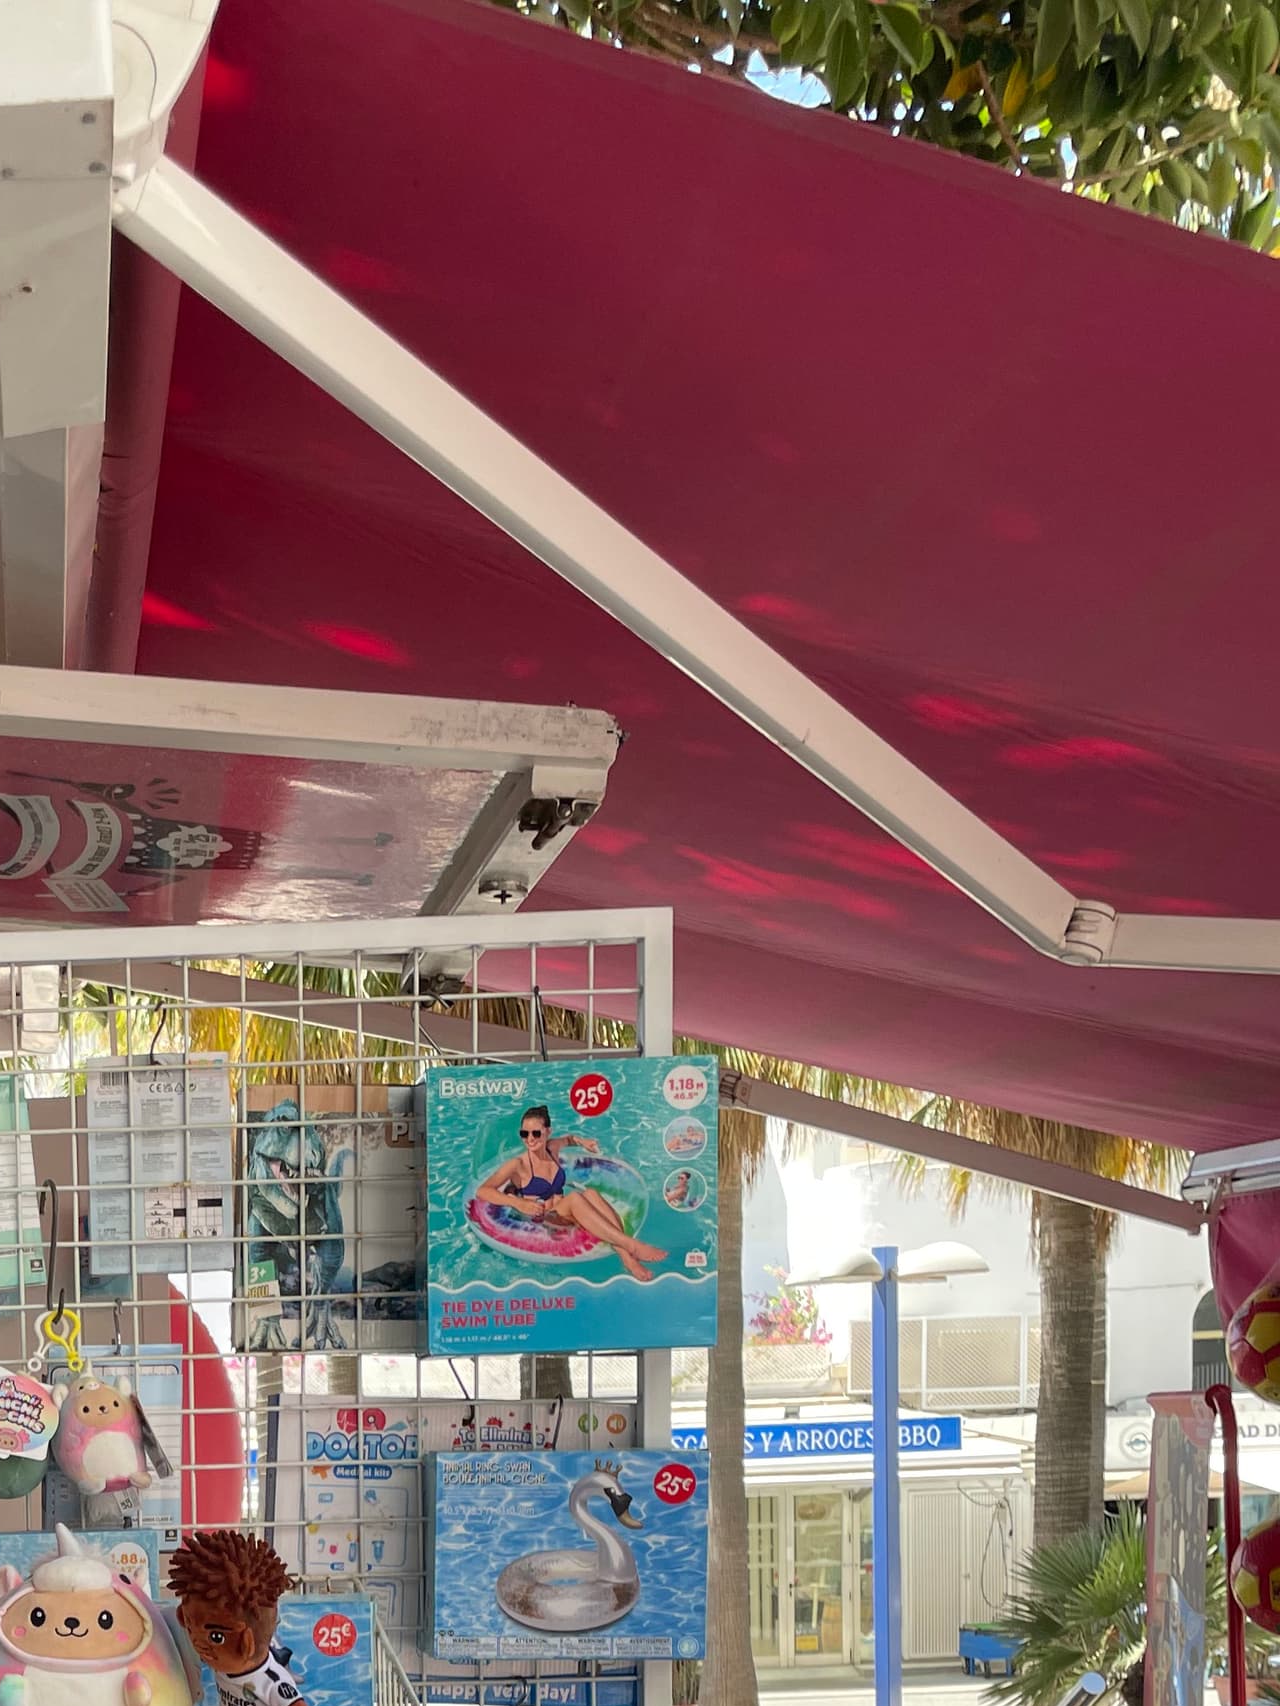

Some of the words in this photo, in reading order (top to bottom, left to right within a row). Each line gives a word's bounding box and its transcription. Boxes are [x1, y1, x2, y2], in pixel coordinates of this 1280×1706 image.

[440, 1078, 527, 1099] Bestway
[669, 1077, 694, 1092] 1.18
[574, 1080, 607, 1111] 25€
[442, 1301, 466, 1314] TIE
[471, 1299, 504, 1313] DYE
[510, 1296, 576, 1312] DELUXE
[441, 1315, 488, 1329] SWIM
[493, 1313, 537, 1327] TUBE
[763, 1431, 774, 1452] Y
[779, 1427, 874, 1452] ARROCES
[899, 1424, 941, 1448] BBQ
[504, 1461, 532, 1473] SWAN
[655, 1471, 694, 1497] 25€
[318, 1621, 352, 1648] 25€
[540, 1682, 577, 1701] day!
